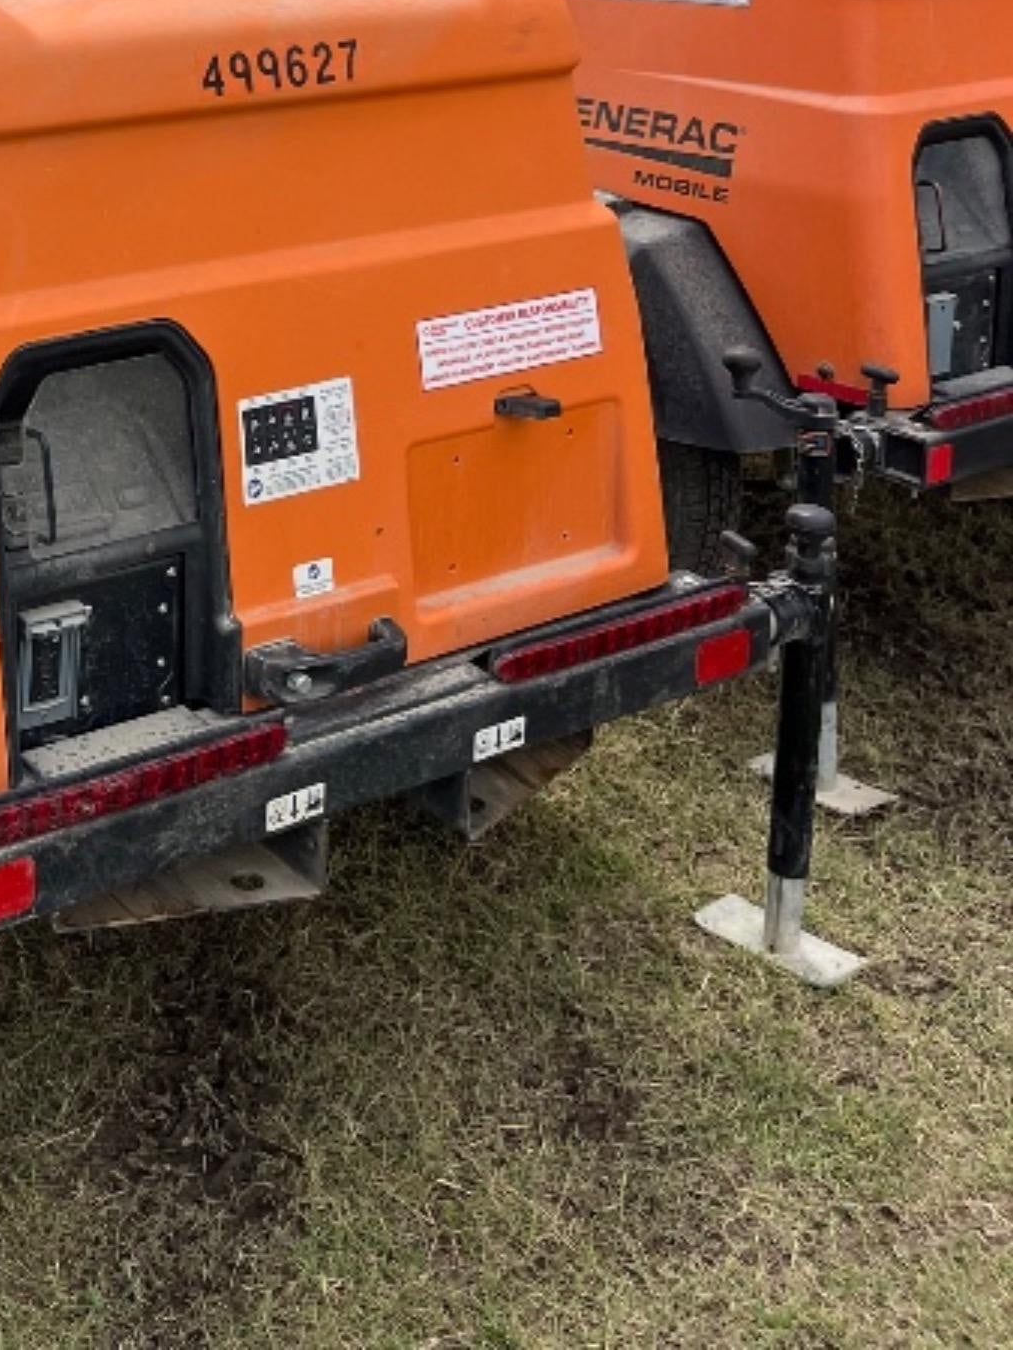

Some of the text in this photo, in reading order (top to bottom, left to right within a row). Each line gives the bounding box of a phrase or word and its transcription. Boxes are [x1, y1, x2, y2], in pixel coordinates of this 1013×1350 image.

[202, 38, 357, 97] 499627
[577, 96, 738, 154] ENERAC
[633, 170, 729, 204] MOBILE
